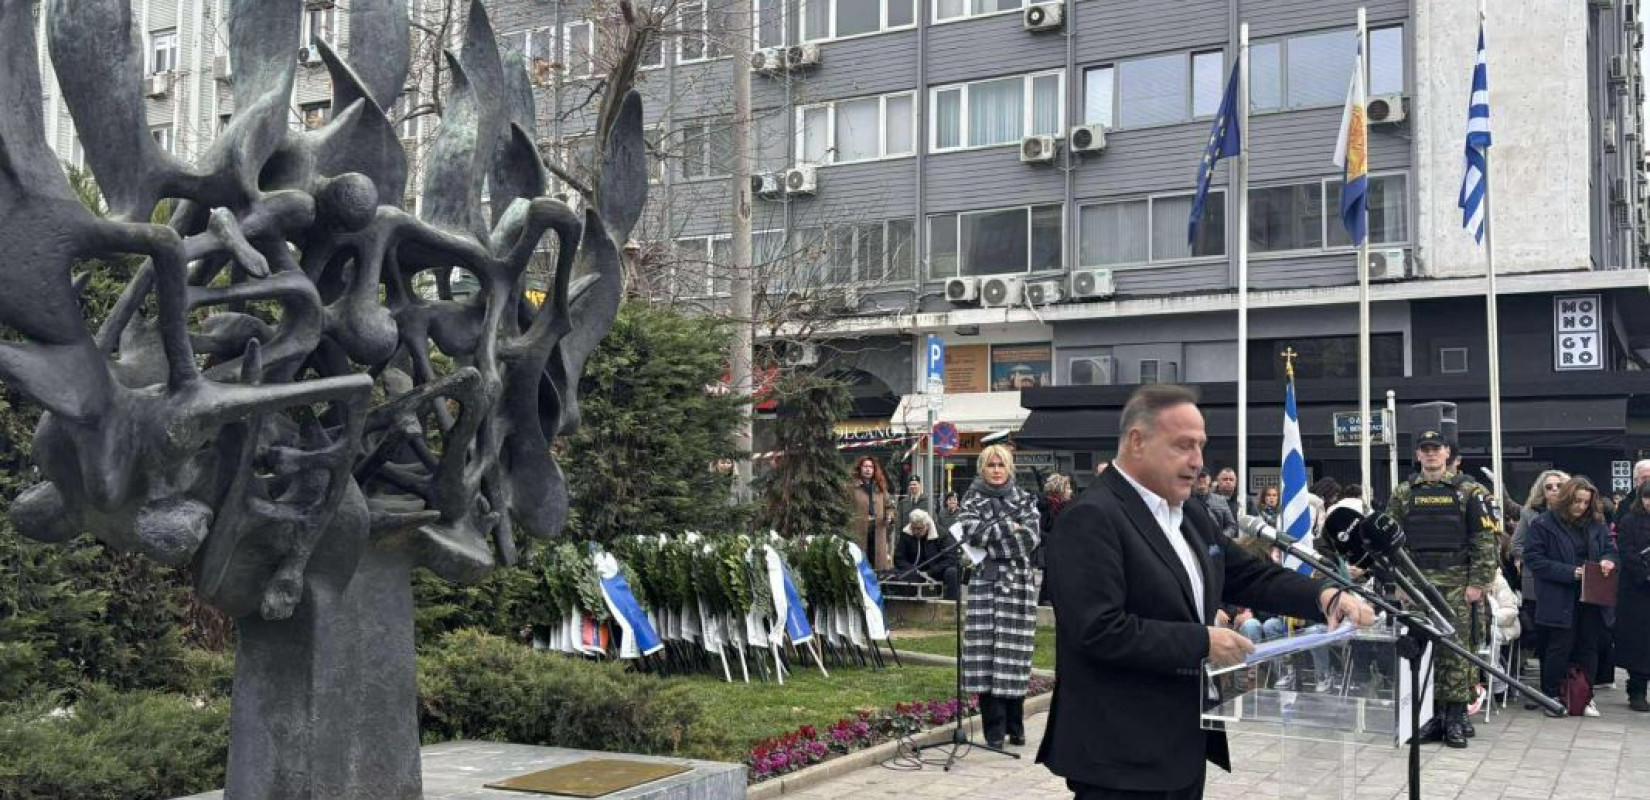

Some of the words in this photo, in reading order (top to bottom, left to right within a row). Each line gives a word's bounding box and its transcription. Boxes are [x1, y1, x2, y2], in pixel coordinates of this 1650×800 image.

[1561, 301, 1593, 313] MO
[1562, 315, 1593, 328] NO
[1562, 336, 1592, 349] GY
[930, 344, 941, 369] P
[1562, 351, 1593, 364] RO
